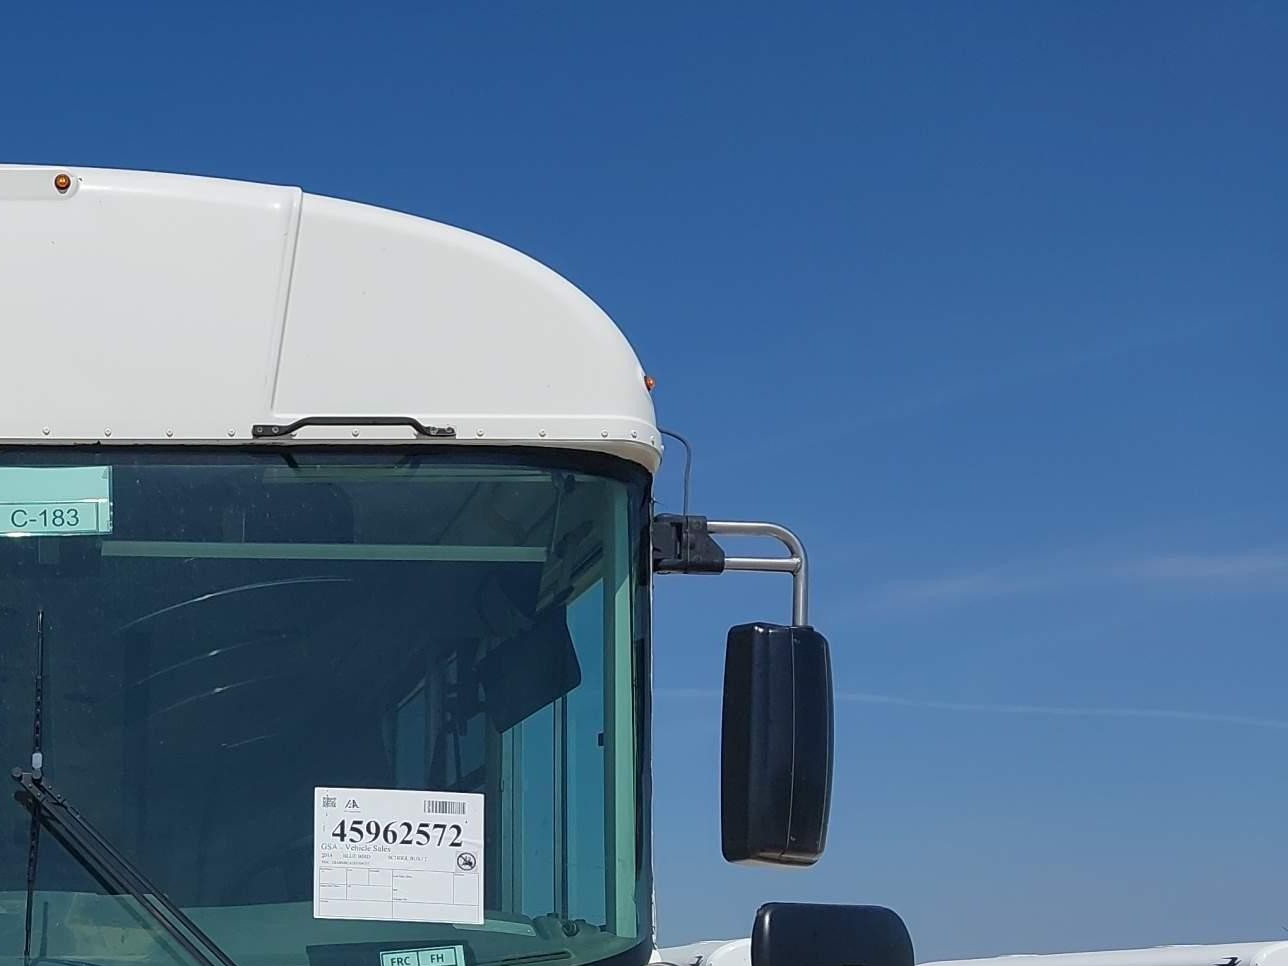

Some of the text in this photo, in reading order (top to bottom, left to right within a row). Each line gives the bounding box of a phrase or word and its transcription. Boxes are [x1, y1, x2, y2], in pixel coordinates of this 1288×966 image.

[10, 508, 80, 528] C-183
[331, 818, 464, 848] 45962572
[320, 843, 338, 851] GSA
[345, 844, 372, 852] Vehicle
[372, 845, 392, 853] Sales
[390, 954, 444, 966] FRC FH
